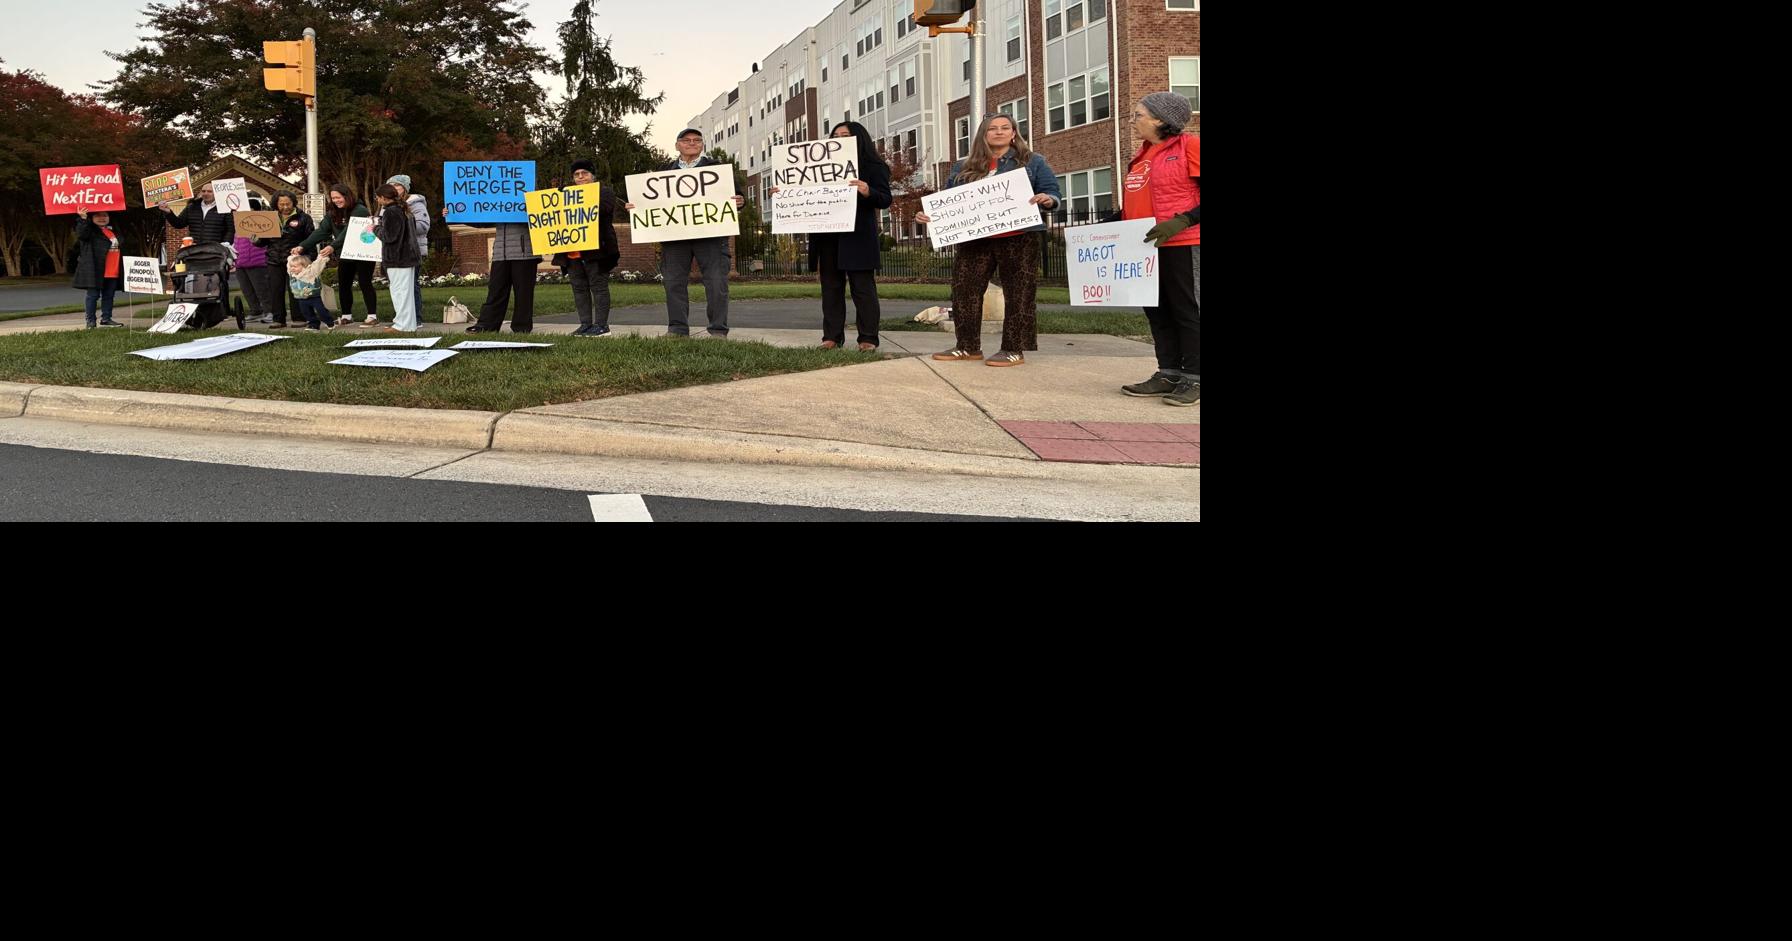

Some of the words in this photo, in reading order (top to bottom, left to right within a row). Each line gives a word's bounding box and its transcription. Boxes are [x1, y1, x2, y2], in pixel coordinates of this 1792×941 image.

[787, 140, 842, 164] STOP
[46, 174, 68, 186] Hit
[71, 172, 91, 184] the
[93, 167, 121, 184] road
[457, 165, 492, 179] DENY
[497, 166, 523, 179] THE
[775, 160, 858, 185] NEXTERA
[145, 176, 168, 190] STOP
[147, 184, 177, 197] NEXTERA'S
[453, 180, 527, 196] MERGER
[642, 171, 719, 200] STOP
[53, 188, 114, 205] NextEra
[541, 192, 559, 209] DO
[562, 189, 584, 206] THE
[796, 189, 820, 197] Chair
[930, 190, 974, 210] BAGOT:
[978, 179, 1010, 198] WHY
[447, 202, 466, 214] no
[474, 201, 527, 213] nextera
[528, 210, 561, 229] RIGHT
[563, 205, 598, 225] THING
[633, 201, 736, 229] NEXTERA
[931, 207, 965, 222] SHOW
[968, 201, 986, 211] UP
[989, 194, 1014, 206] FOR
[241, 220, 271, 230] Merger
[935, 214, 981, 235] DOMINION
[986, 206, 1018, 221] BUT
[939, 231, 963, 244] NOT
[967, 214, 1039, 237] RATEPAYERS?
[547, 226, 588, 247] BAGOT
[1078, 244, 1115, 263] BAGOT
[1097, 266, 1107, 278] IS
